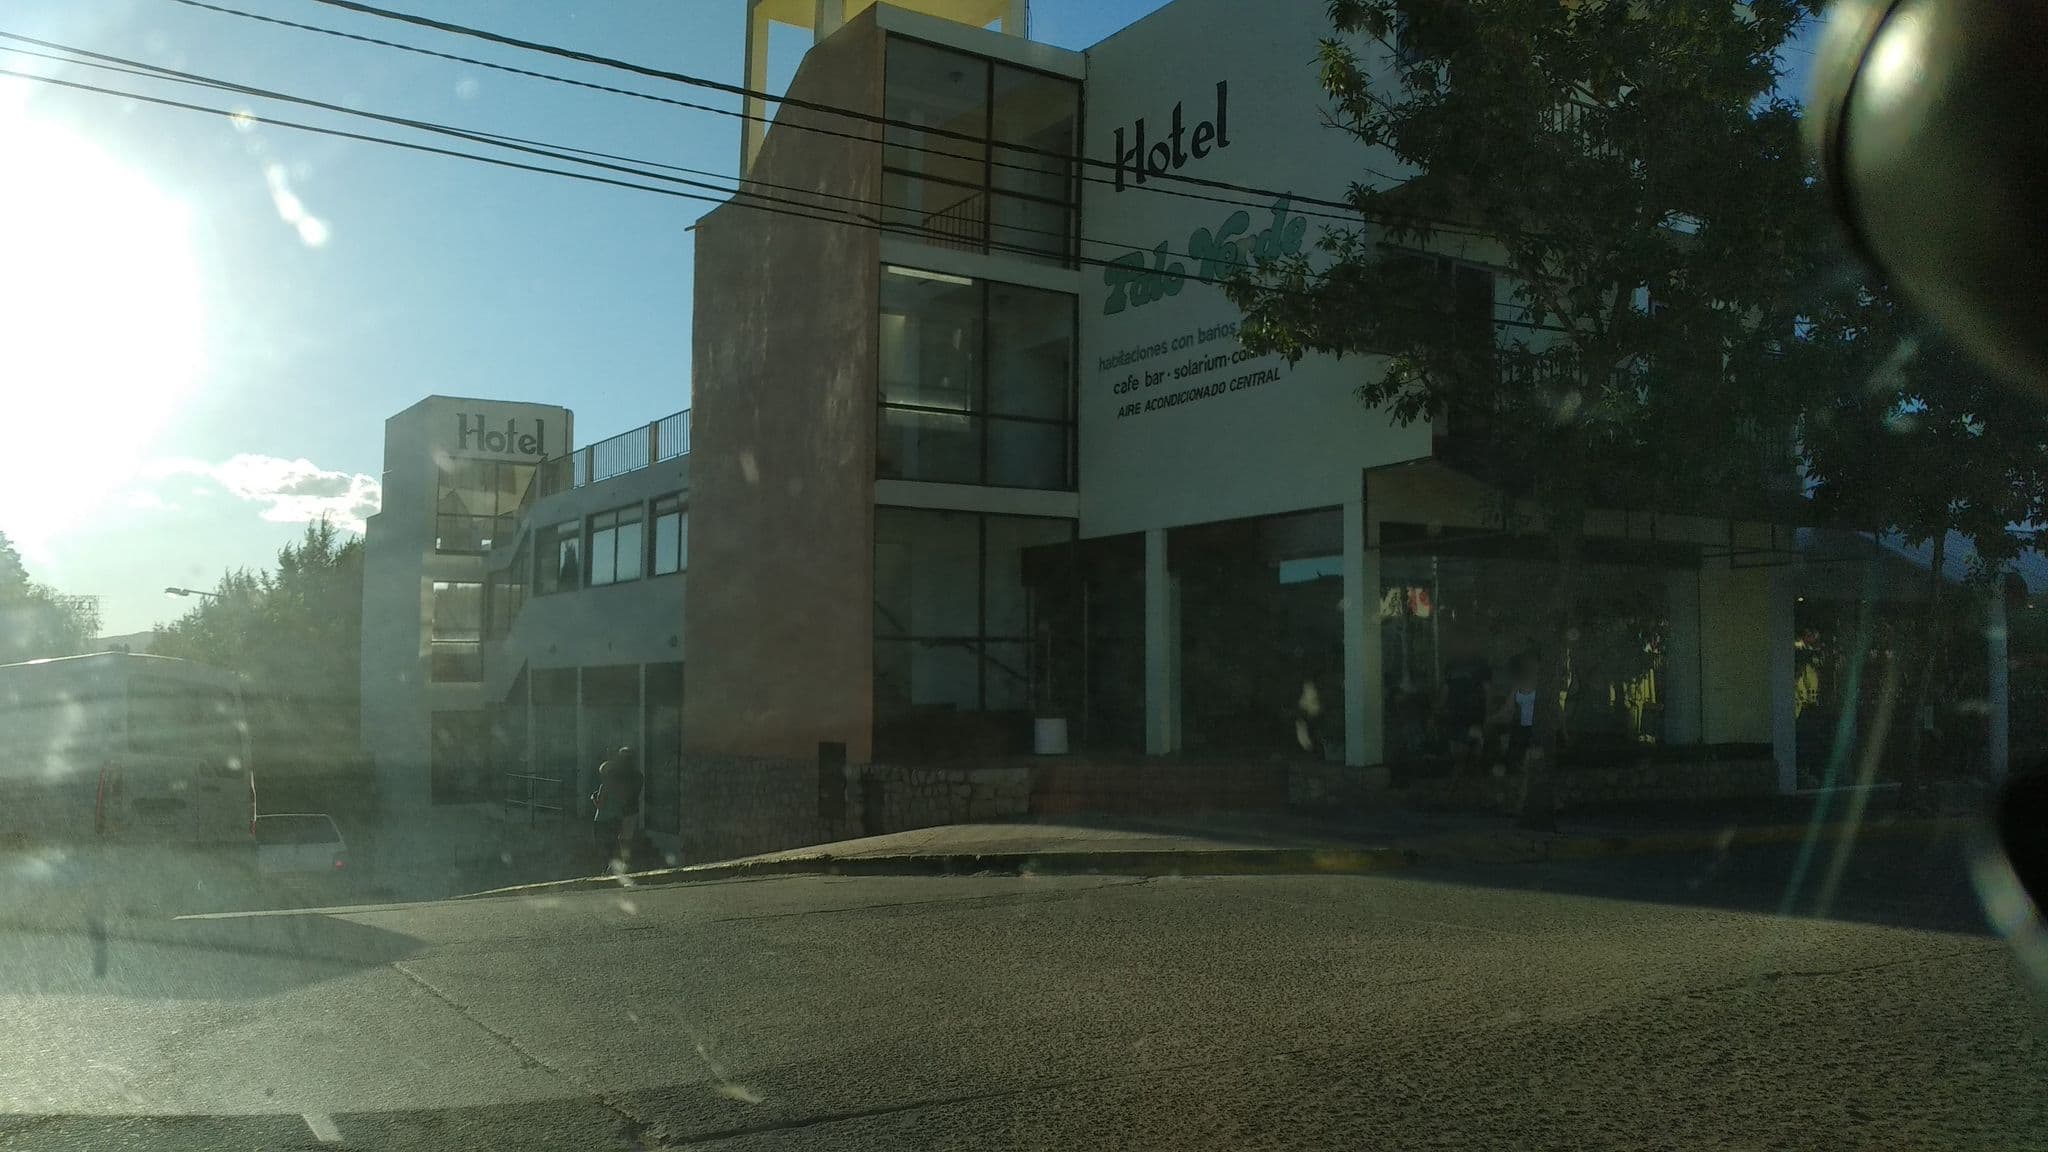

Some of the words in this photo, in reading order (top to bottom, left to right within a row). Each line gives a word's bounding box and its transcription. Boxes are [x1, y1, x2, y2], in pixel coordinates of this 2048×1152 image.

[1114, 80, 1230, 192] Hotel
[1104, 240, 1185, 315] Palo
[1189, 191, 1307, 284] Verde
[1099, 342, 1167, 371] habitaciones
[1172, 335, 1193, 351] con
[1118, 402, 1141, 418] AIRE
[1144, 381, 1226, 412] ACONDICIONADO
[1229, 368, 1280, 392] CENTRAL
[456, 413, 549, 457] Hotel
